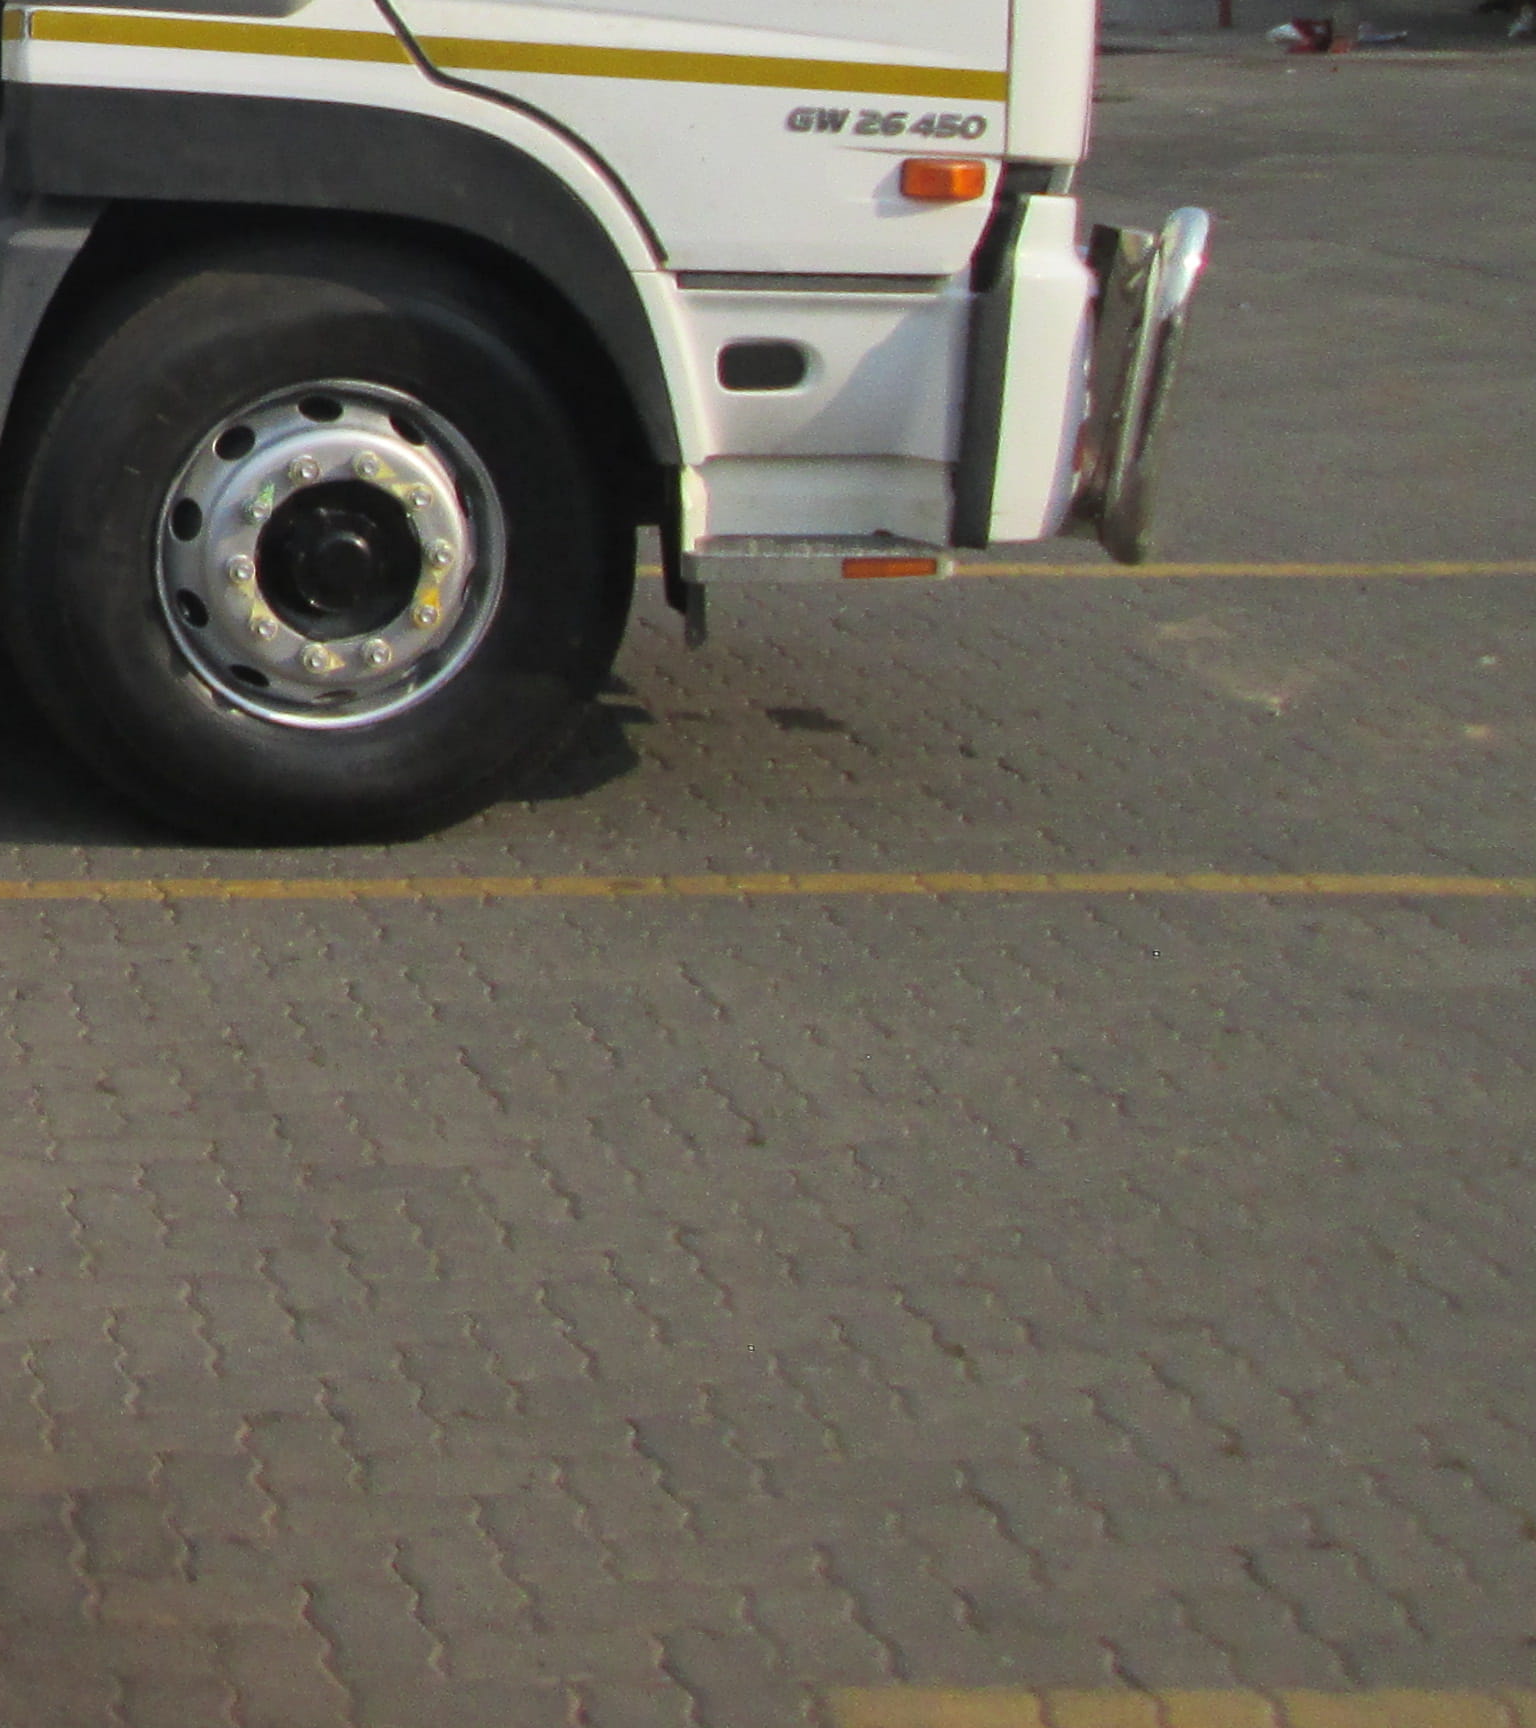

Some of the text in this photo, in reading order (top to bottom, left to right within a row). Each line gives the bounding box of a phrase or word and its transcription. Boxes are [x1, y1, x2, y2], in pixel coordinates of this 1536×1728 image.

[785, 106, 988, 140] GW 26 450
